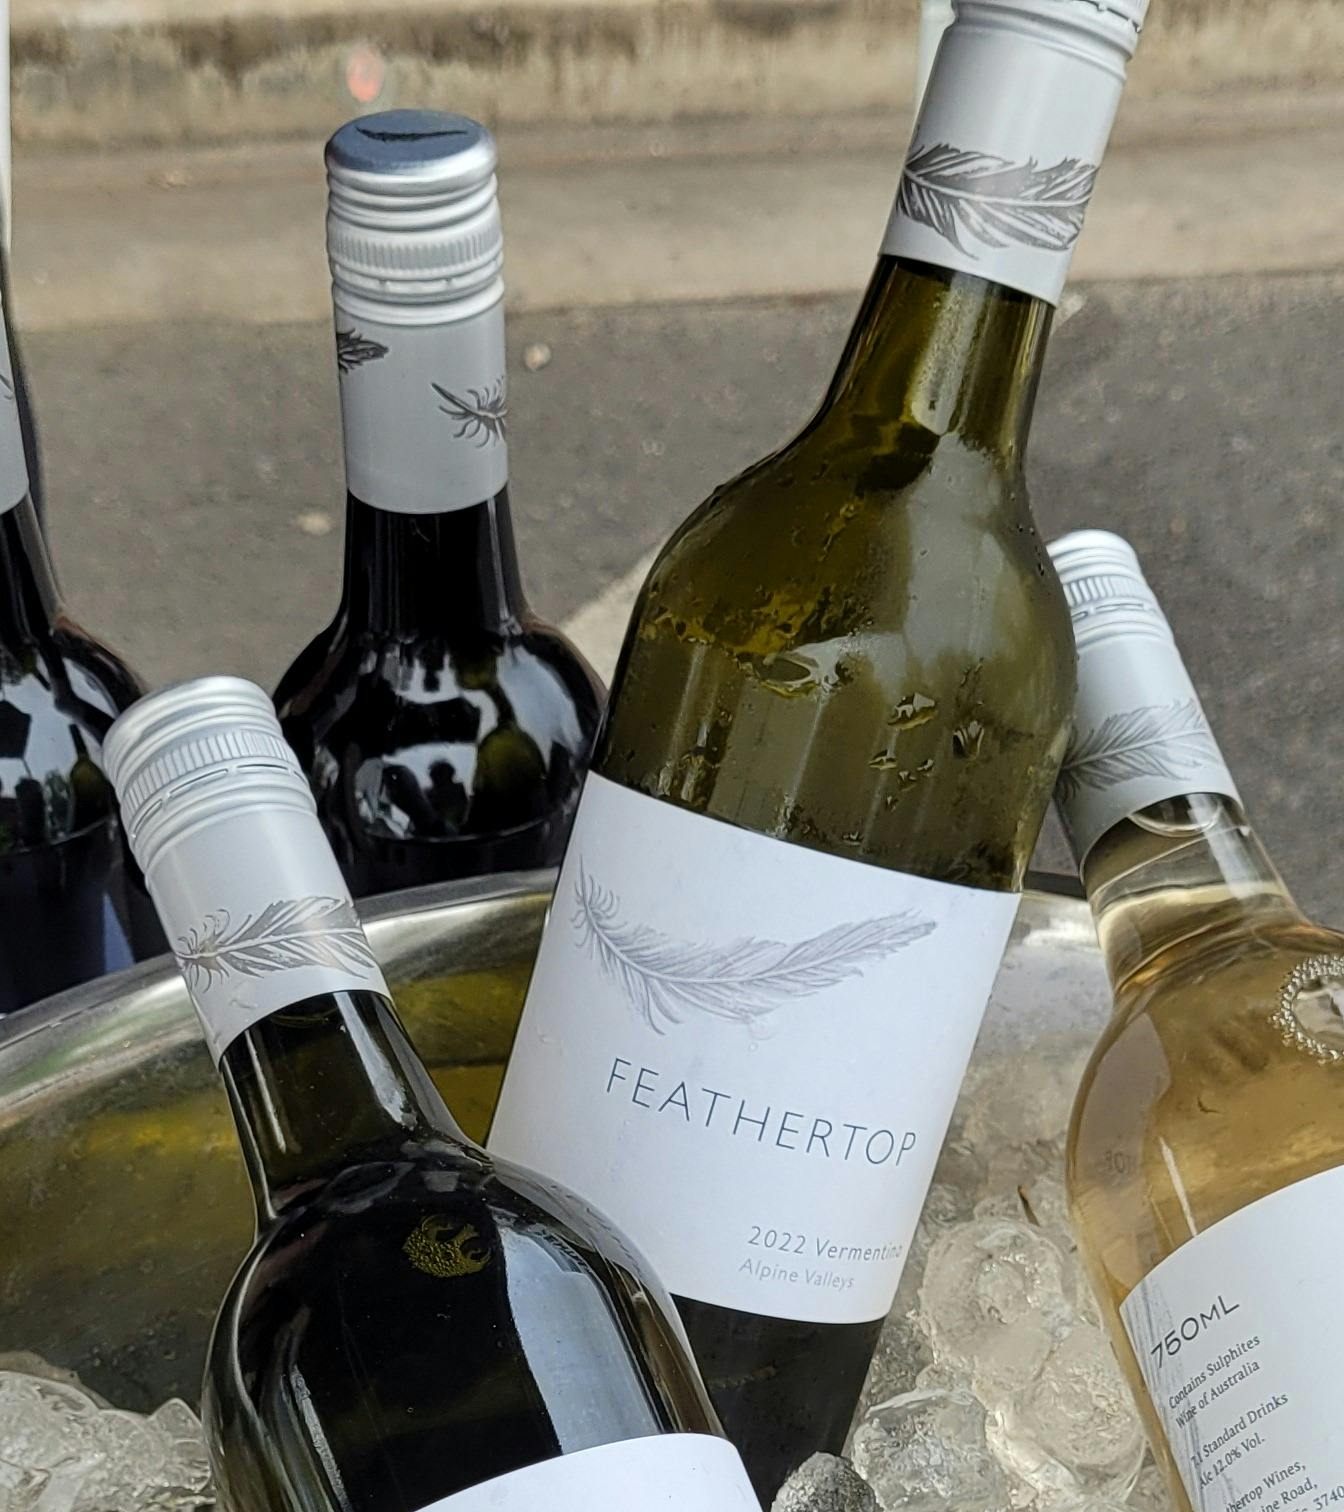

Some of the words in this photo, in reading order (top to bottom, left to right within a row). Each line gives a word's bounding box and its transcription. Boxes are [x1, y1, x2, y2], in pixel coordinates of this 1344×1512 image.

[606, 1057, 917, 1166] FEATHERTOP
[747, 1225, 806, 1255] 2022
[738, 1257, 799, 1283] Alpine
[805, 1268, 855, 1292] Valleys
[1150, 1295, 1240, 1369] 750ML
[1168, 1371, 1207, 1410] Contains
[1206, 1335, 1261, 1377] Sulphites
[1175, 1405, 1198, 1429] Wine
[1198, 1392, 1210, 1410] of
[1210, 1361, 1260, 1401] Australia
[1202, 1416, 1248, 1458] Standard
[1246, 1394, 1289, 1425] Drinks
[1212, 1446, 1242, 1477] 12.0%
[1240, 1432, 1265, 1452] Vol.
[1262, 1461, 1306, 1489] Wines,
[1279, 1476, 1318, 1505] Road,
